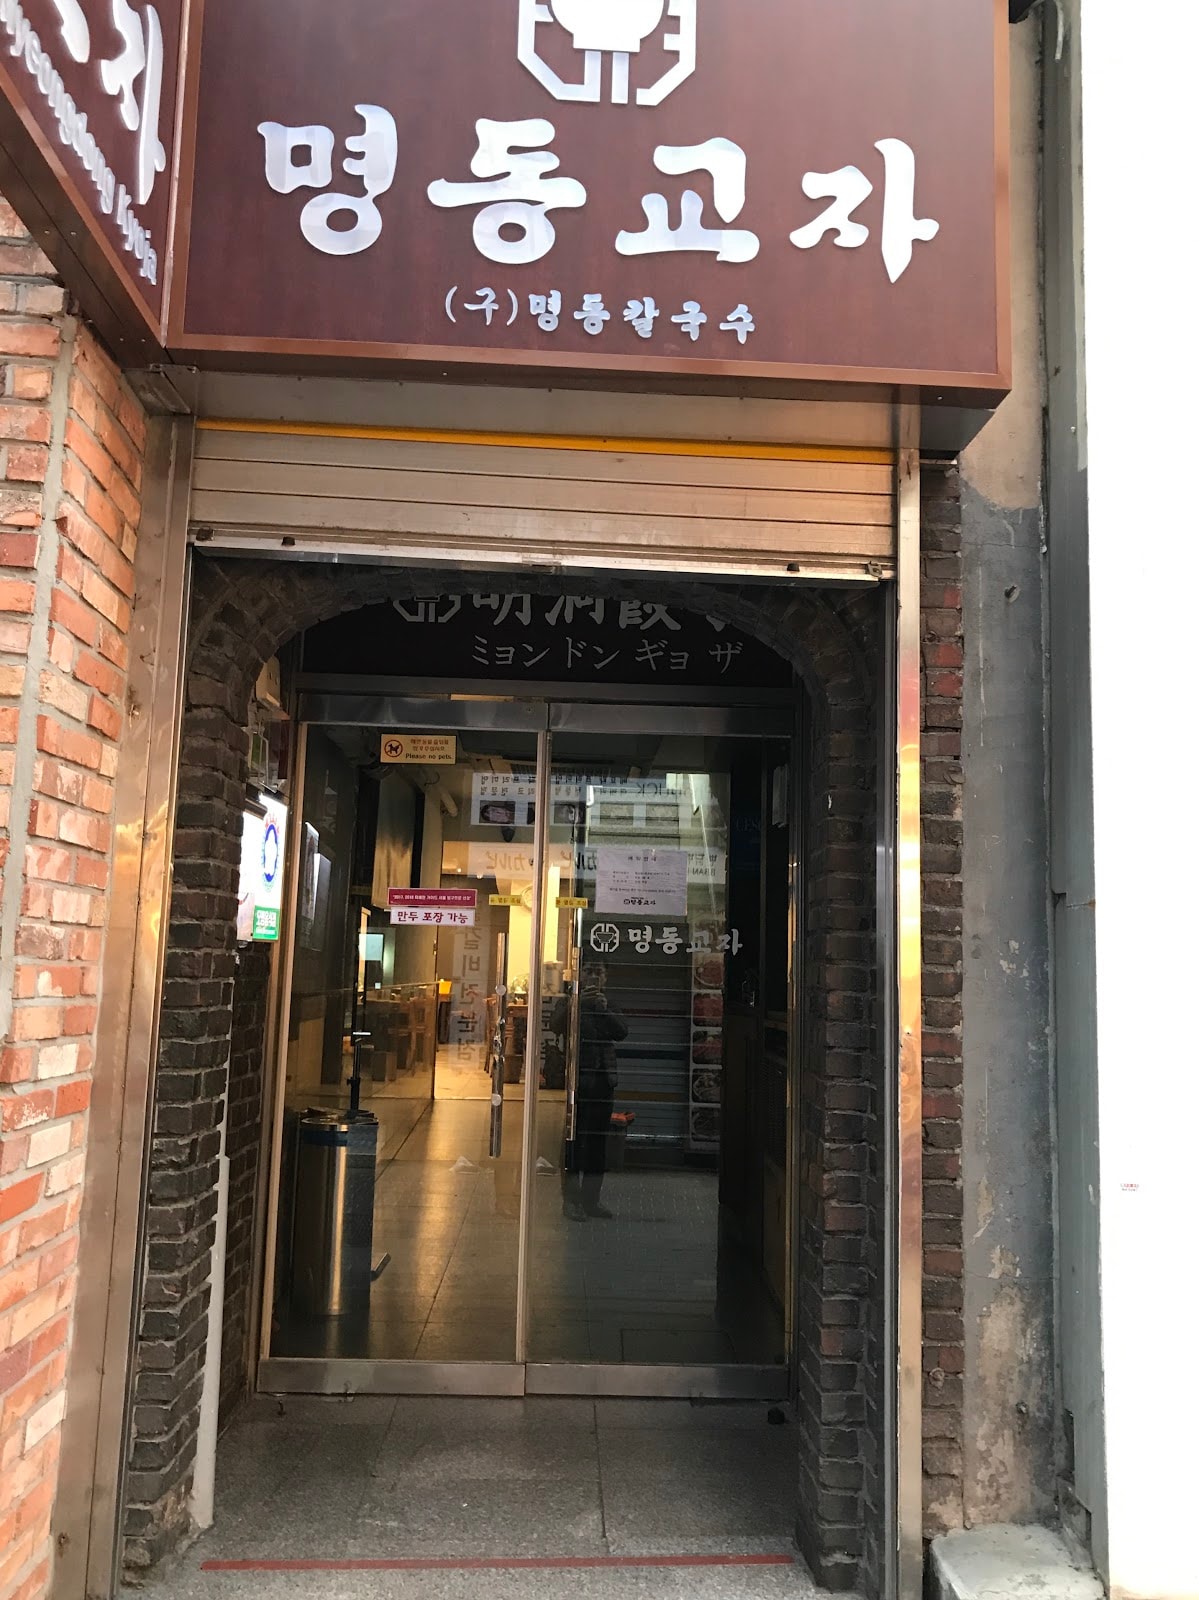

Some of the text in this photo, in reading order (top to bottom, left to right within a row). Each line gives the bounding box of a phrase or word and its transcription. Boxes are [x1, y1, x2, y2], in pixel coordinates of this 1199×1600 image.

[257, 104, 940, 284] 명동교자
[117, 184, 157, 286] Kyoja
[472, 591, 731, 632] 明洞餃
[397, 911, 468, 924] 만두 포장 가능
[627, 925, 743, 956] 명동교자
